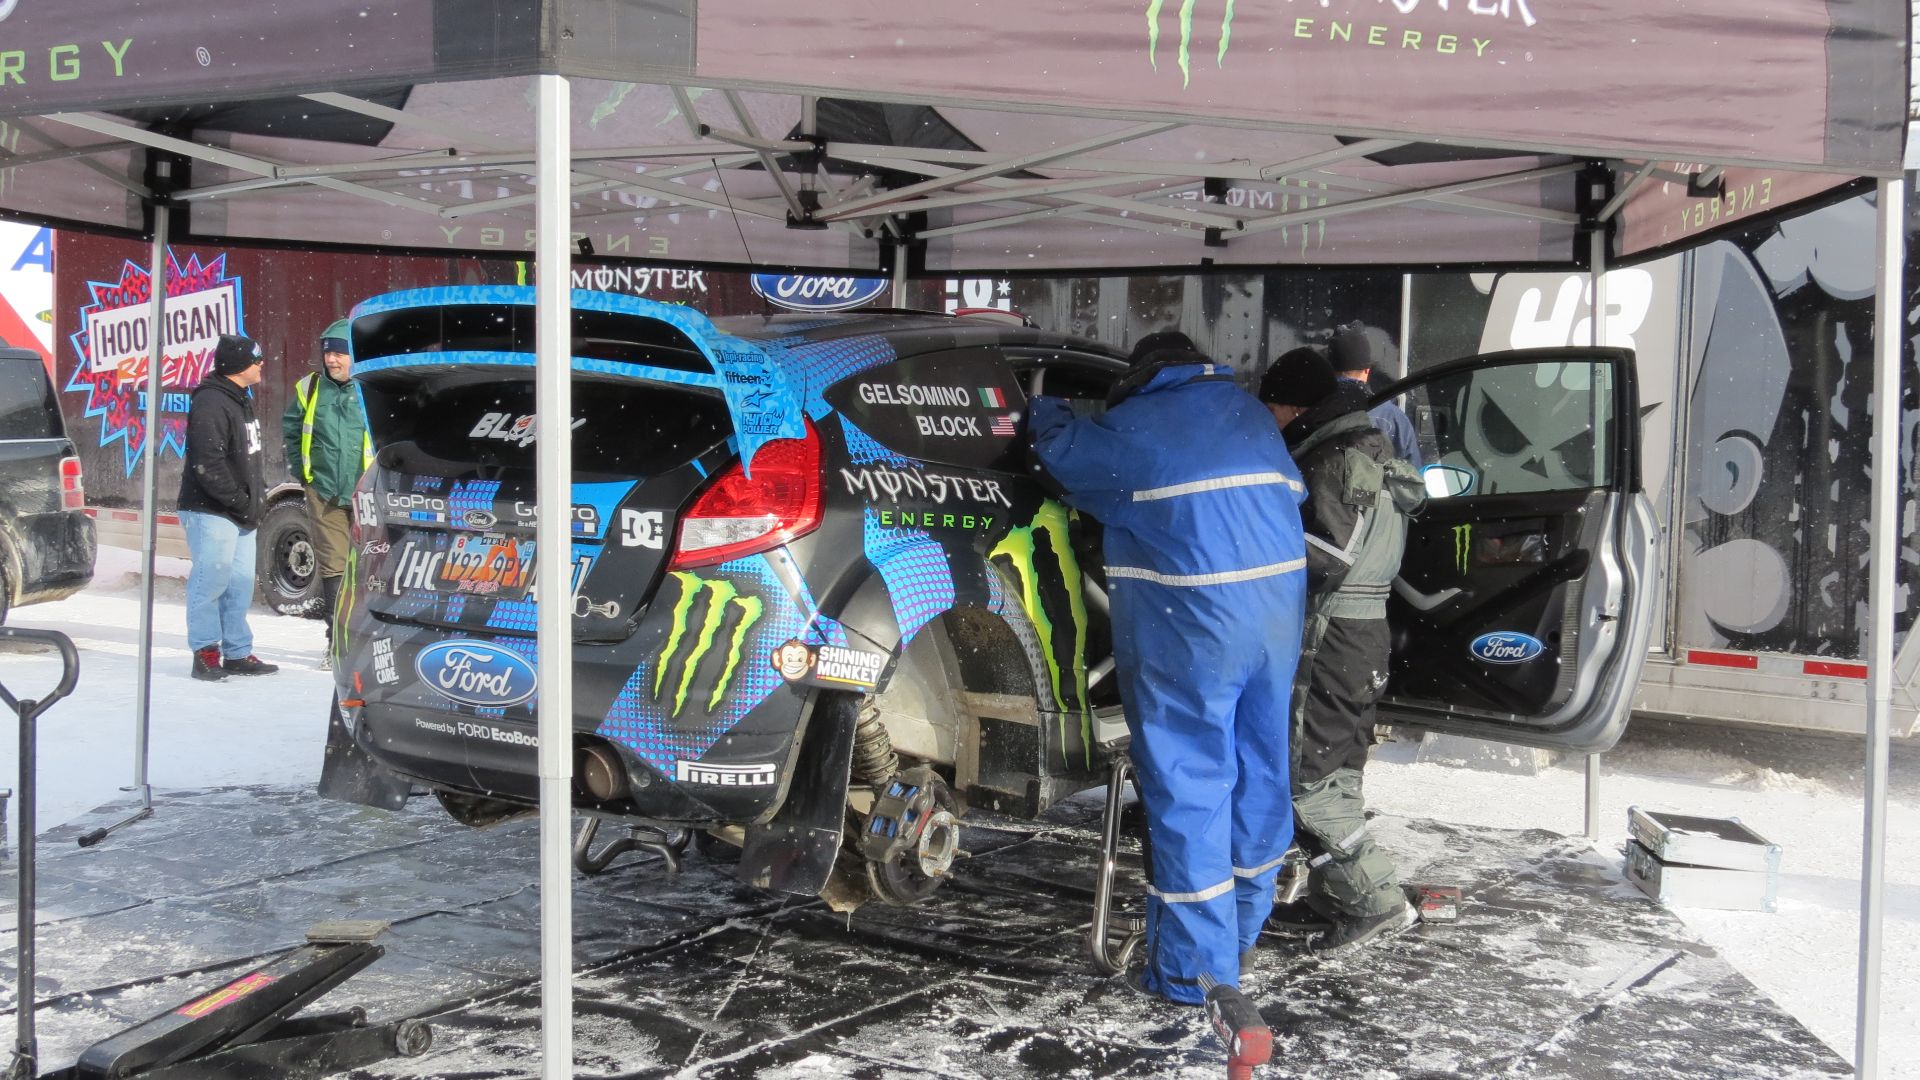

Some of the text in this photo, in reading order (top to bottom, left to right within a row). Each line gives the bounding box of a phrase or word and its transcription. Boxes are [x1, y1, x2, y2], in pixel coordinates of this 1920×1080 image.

[1294, 18, 1491, 57] ENERGY
[571, 265, 707, 294] MONSTER
[859, 383, 970, 407] GELSOMINO
[916, 415, 982, 437] BLOCK
[840, 464, 1012, 509] MONSTER
[387, 492, 445, 511] GoPro
[469, 513, 488, 525] Ford
[881, 510, 993, 529] ENERGY
[372, 638, 393, 656] JUST
[819, 646, 880, 669] SHINING
[1483, 637, 1527, 658] Ford
[374, 652, 395, 671] AIN'T
[439, 648, 513, 697] Ford
[817, 661, 879, 683] MONKEY
[415, 718, 540, 747] Powered by FORD EcoBoo
[677, 759, 776, 786] PIRELLI
